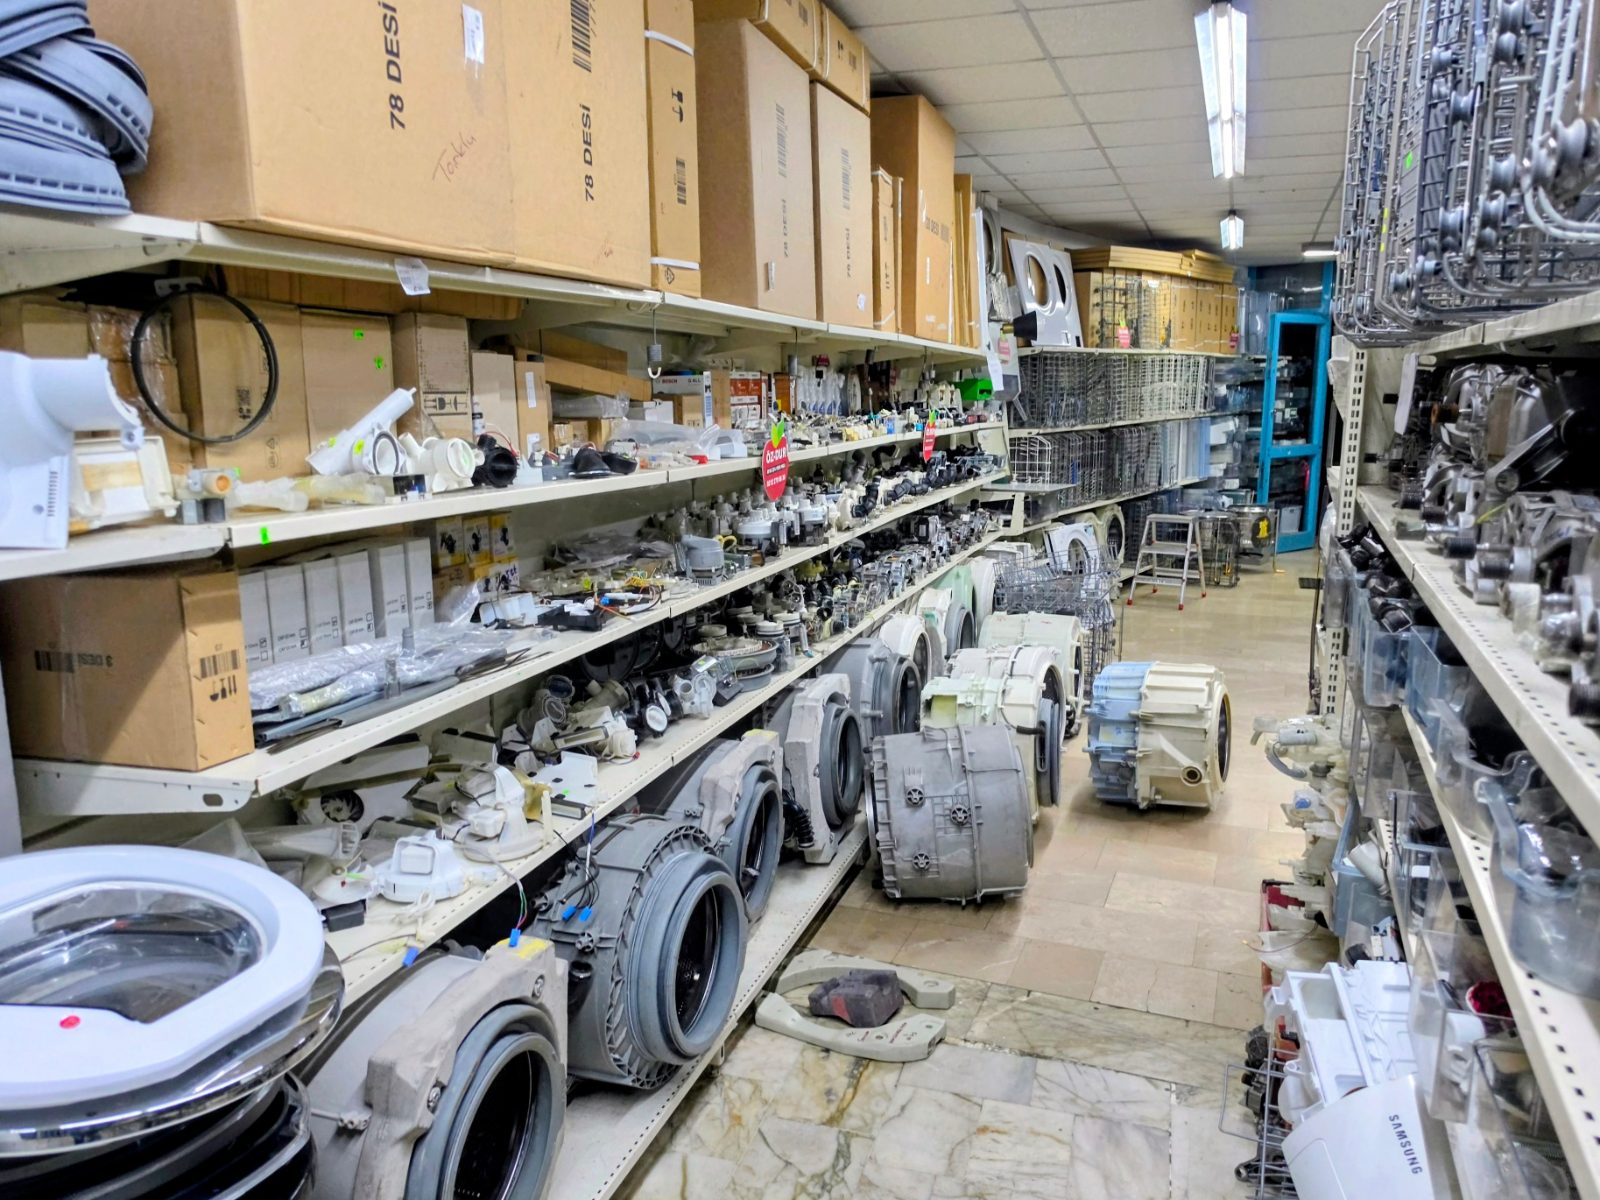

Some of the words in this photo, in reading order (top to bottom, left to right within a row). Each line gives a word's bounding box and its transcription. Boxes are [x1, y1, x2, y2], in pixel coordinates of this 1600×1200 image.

[389, 93, 406, 130] 78
[585, 174, 595, 202] 78
[1388, 1114, 1423, 1174] SAMSUNG
